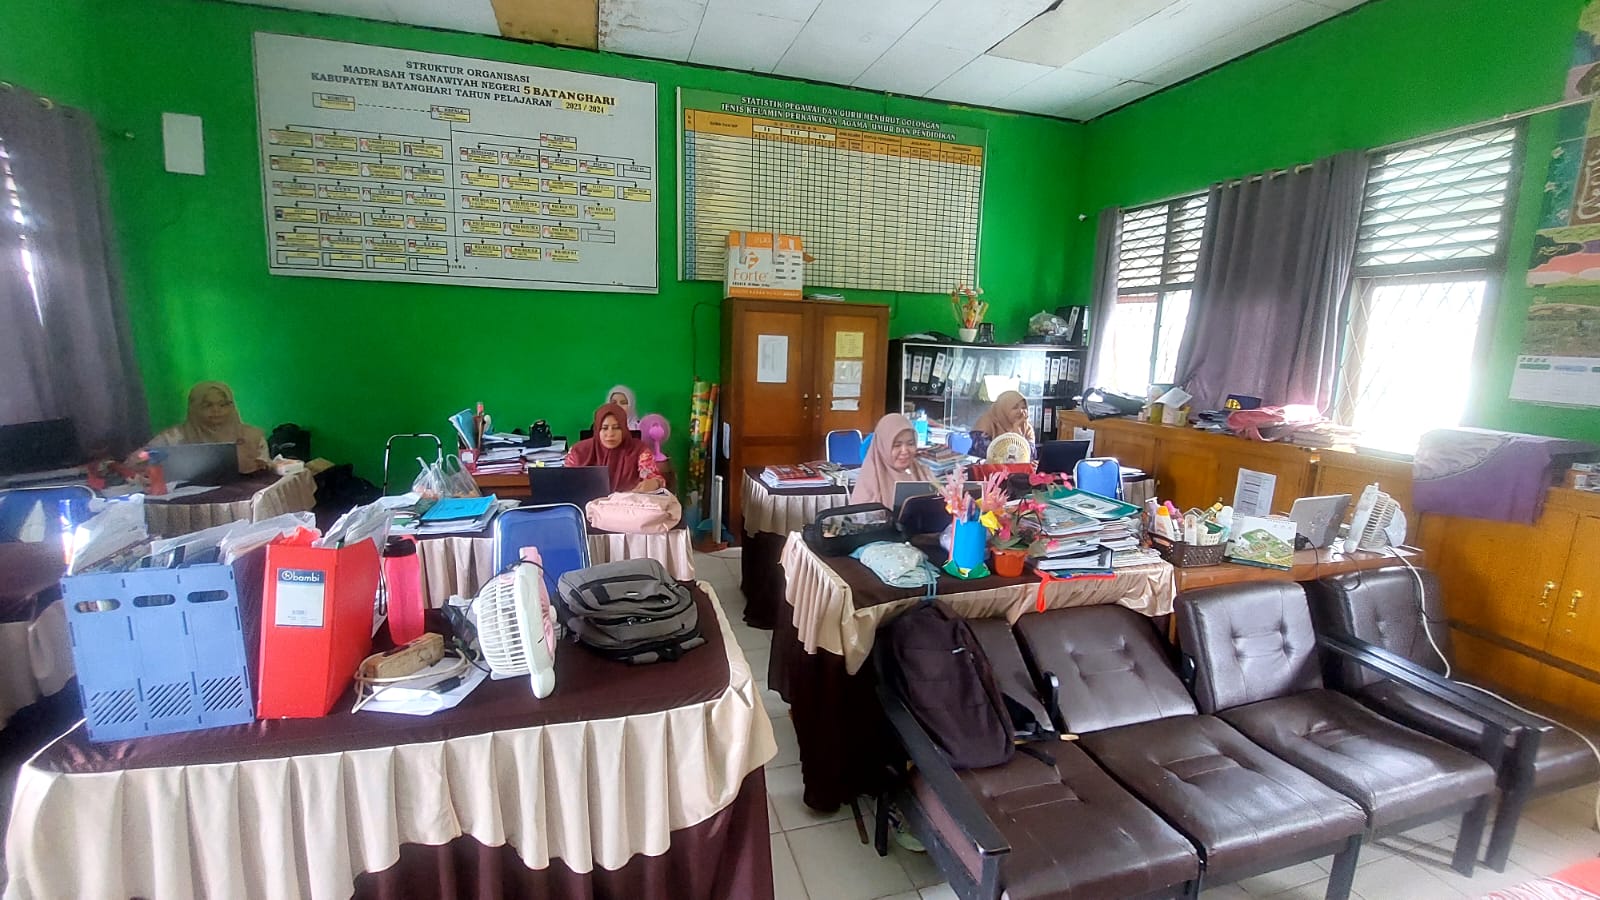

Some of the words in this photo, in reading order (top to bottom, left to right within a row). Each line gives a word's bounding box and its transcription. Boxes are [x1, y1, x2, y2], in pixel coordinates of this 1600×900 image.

[342, 64, 405, 79] MADRASAH
[409, 72, 478, 87] TSANAWIYAH
[481, 81, 521, 93] NEGERI
[523, 85, 531, 95] 5
[533, 87, 616, 106] BATANGHARI
[406, 61, 464, 75] STRUKTUR
[466, 68, 530, 83] ORGANISASI
[311, 72, 378, 87] KABUPATEN
[382, 80, 452, 96] BATANGHARI
[455, 88, 491, 100] TAHUN
[494, 93, 553, 107] PELAJARAN
[741, 96, 783, 108] STATISTIK
[785, 102, 820, 113] PEGAWAI
[822, 107, 838, 116] DAN
[840, 109, 862, 119] GURU
[863, 112, 900, 124] MENURUT
[901, 118, 940, 130] GOLONGAN
[746, 106, 783, 118] KELAMIN
[785, 111, 838, 125] PERKAWINAN
[841, 119, 868, 129] AGAMA
[871, 123, 895, 133] UMUR
[896, 127, 911, 135] DAN
[912, 129, 956, 141] PENDIDIKAN
[733, 267, 767, 282] Forte
[292, 571, 320, 582] bambi
